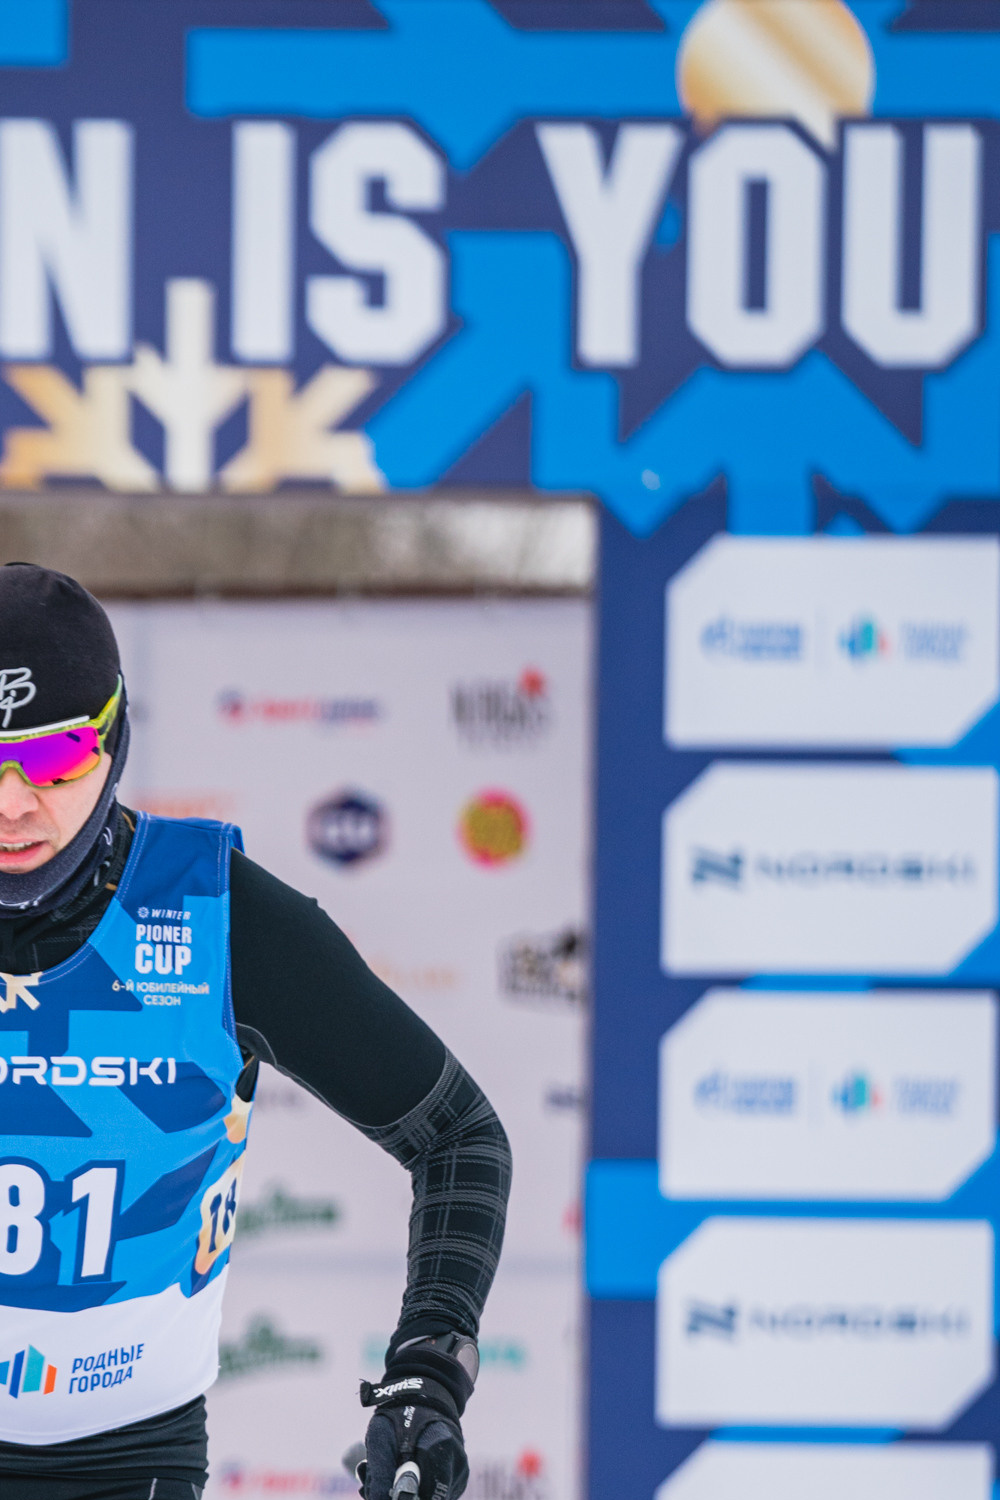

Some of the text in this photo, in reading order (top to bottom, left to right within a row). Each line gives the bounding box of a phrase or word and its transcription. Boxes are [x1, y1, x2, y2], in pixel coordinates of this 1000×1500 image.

[232, 119, 448, 366] IS
[534, 121, 981, 369] YOU
[151, 908, 192, 920] WINTER
[136, 924, 192, 944] PIONER
[134, 943, 192, 975] CUP
[112, 979, 210, 995] 6-Й ЮБИЛЕЙНЫЙ
[142, 994, 182, 1006] СЕЗОН
[71, 1343, 145, 1374] РОДНЫЕ
[68, 1365, 133, 1394] ГОРОДА
